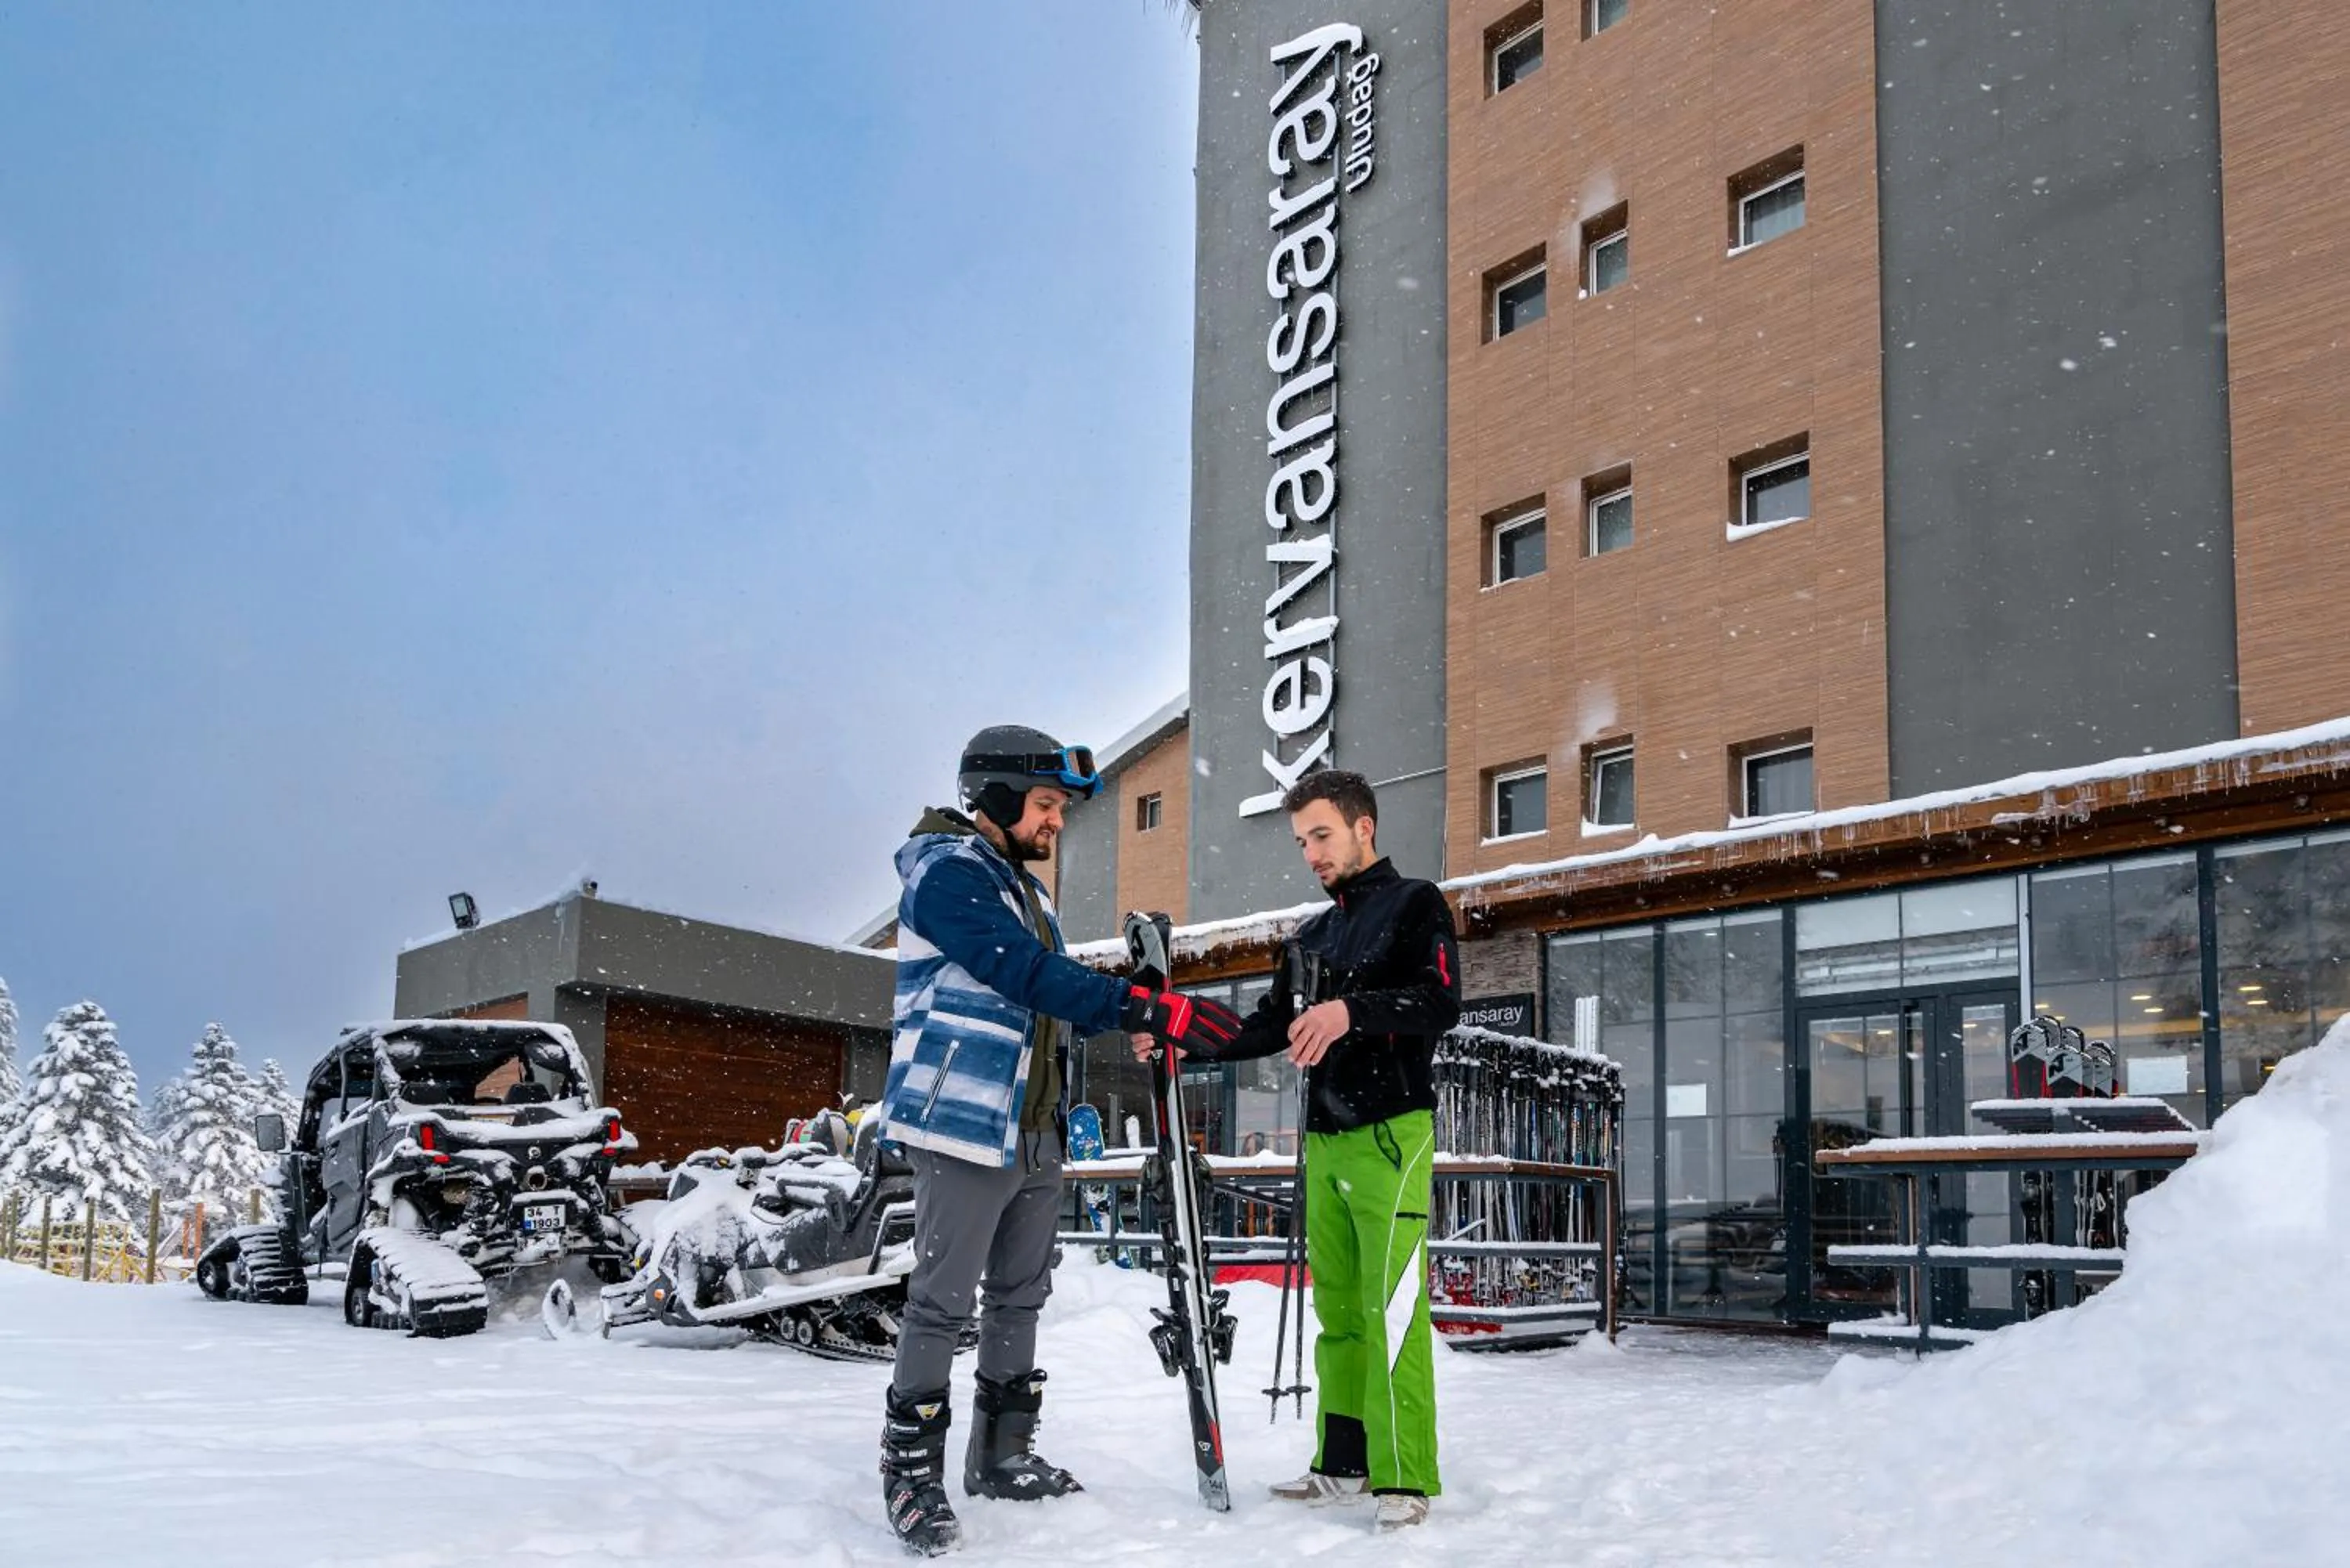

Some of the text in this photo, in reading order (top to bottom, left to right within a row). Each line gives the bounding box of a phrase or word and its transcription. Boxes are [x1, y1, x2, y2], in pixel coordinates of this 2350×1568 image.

[1345, 52, 1379, 192] Uludağ
[1238, 23, 1363, 818] kervansaray
[1459, 1005, 1524, 1024] ansaray
[527, 1205, 560, 1217] 34 T
